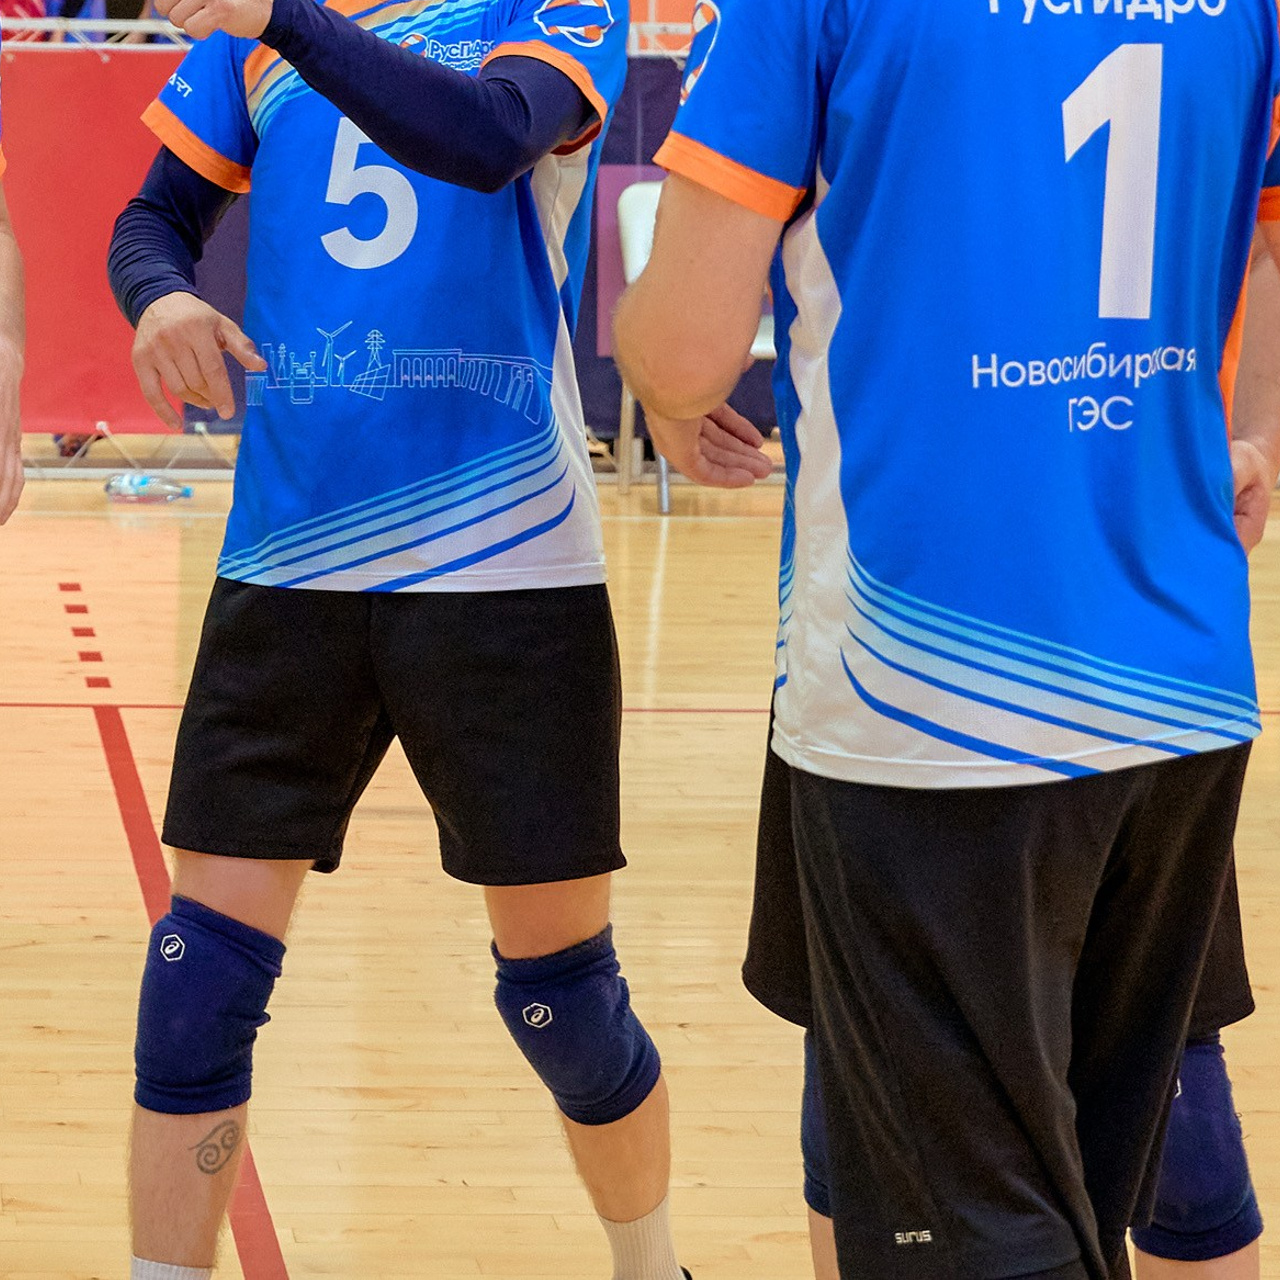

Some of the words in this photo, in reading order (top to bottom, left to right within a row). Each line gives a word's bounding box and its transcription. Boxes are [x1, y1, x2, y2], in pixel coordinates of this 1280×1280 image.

[320, 116, 419, 270] 5
[1062, 43, 1163, 320] 1
[1069, 396, 1134, 433] ГЭС
